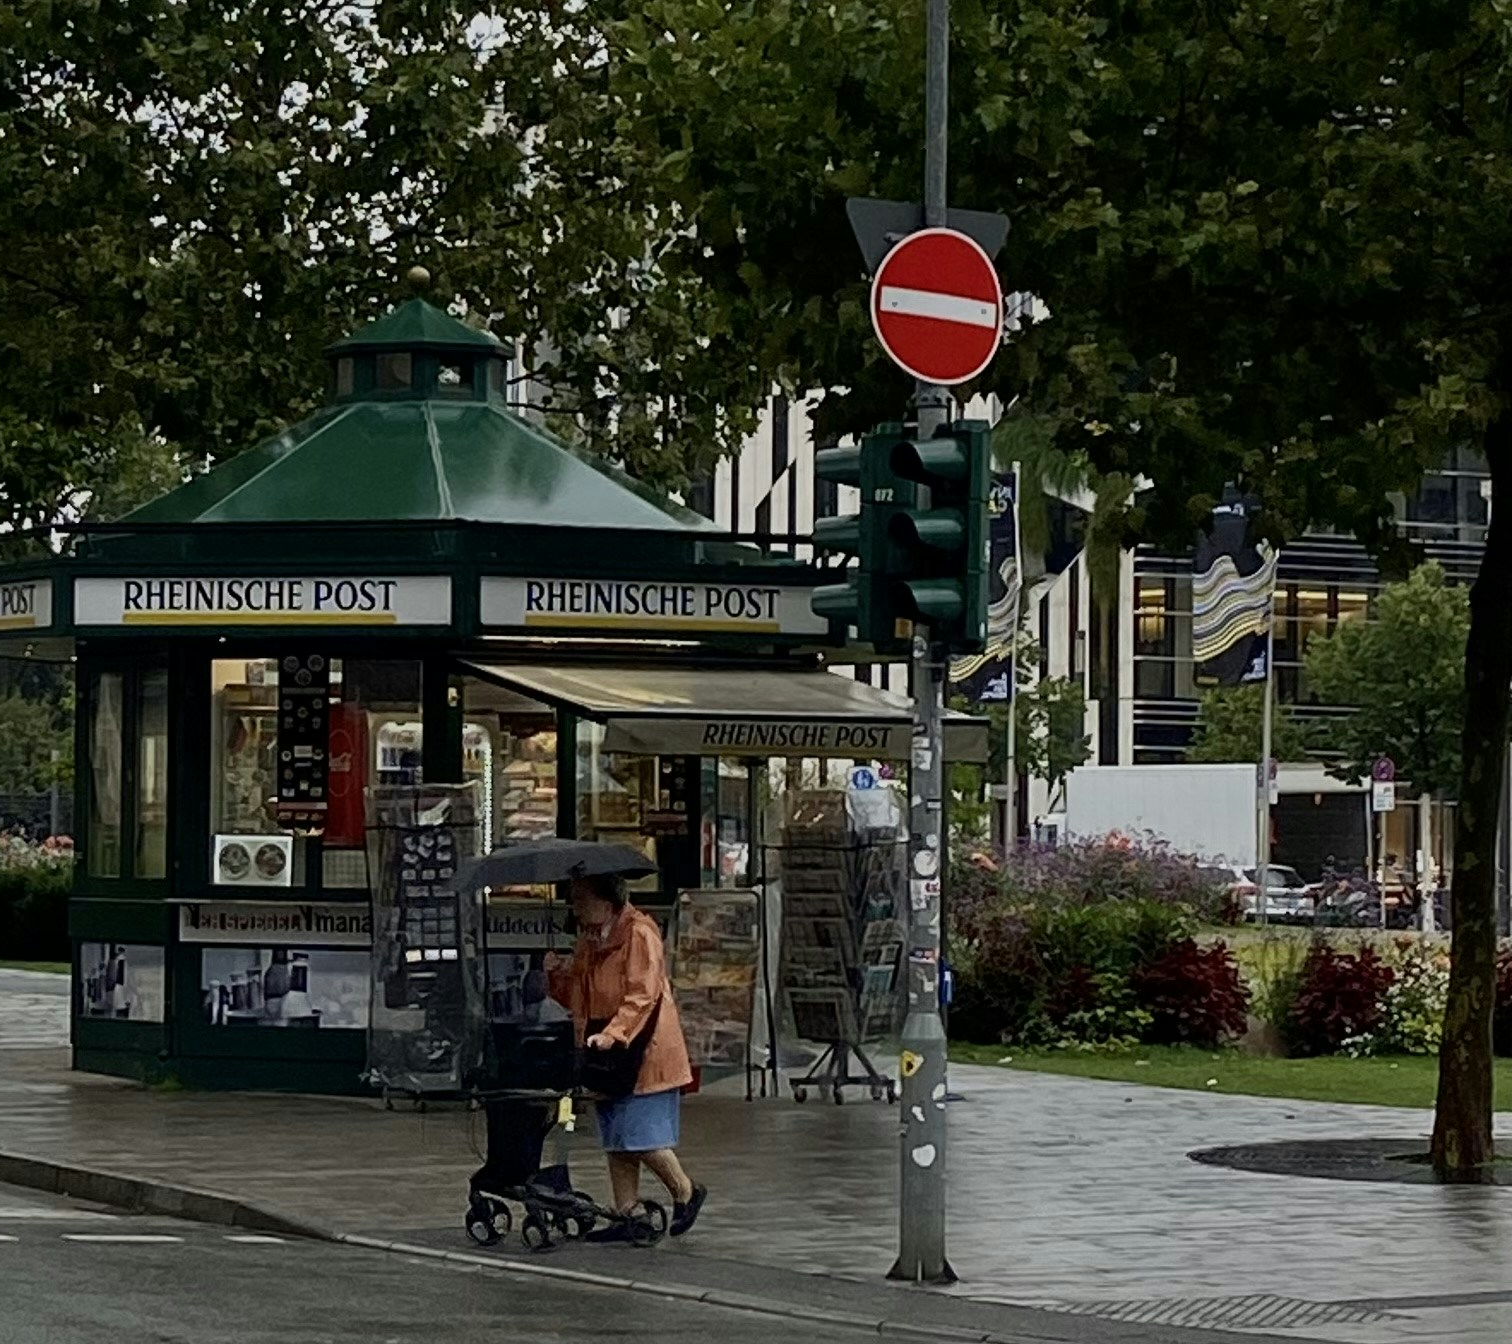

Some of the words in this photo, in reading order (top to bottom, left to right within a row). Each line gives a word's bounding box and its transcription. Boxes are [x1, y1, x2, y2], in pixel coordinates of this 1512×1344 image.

[1, 584, 36, 616] POST
[123, 580, 303, 611] RHEINISCHE
[313, 580, 397, 611] POST
[525, 581, 695, 616] RHEINISCHE
[704, 586, 780, 618] POST
[703, 723, 831, 747] RHEINISCHE
[835, 726, 892, 748] POST
